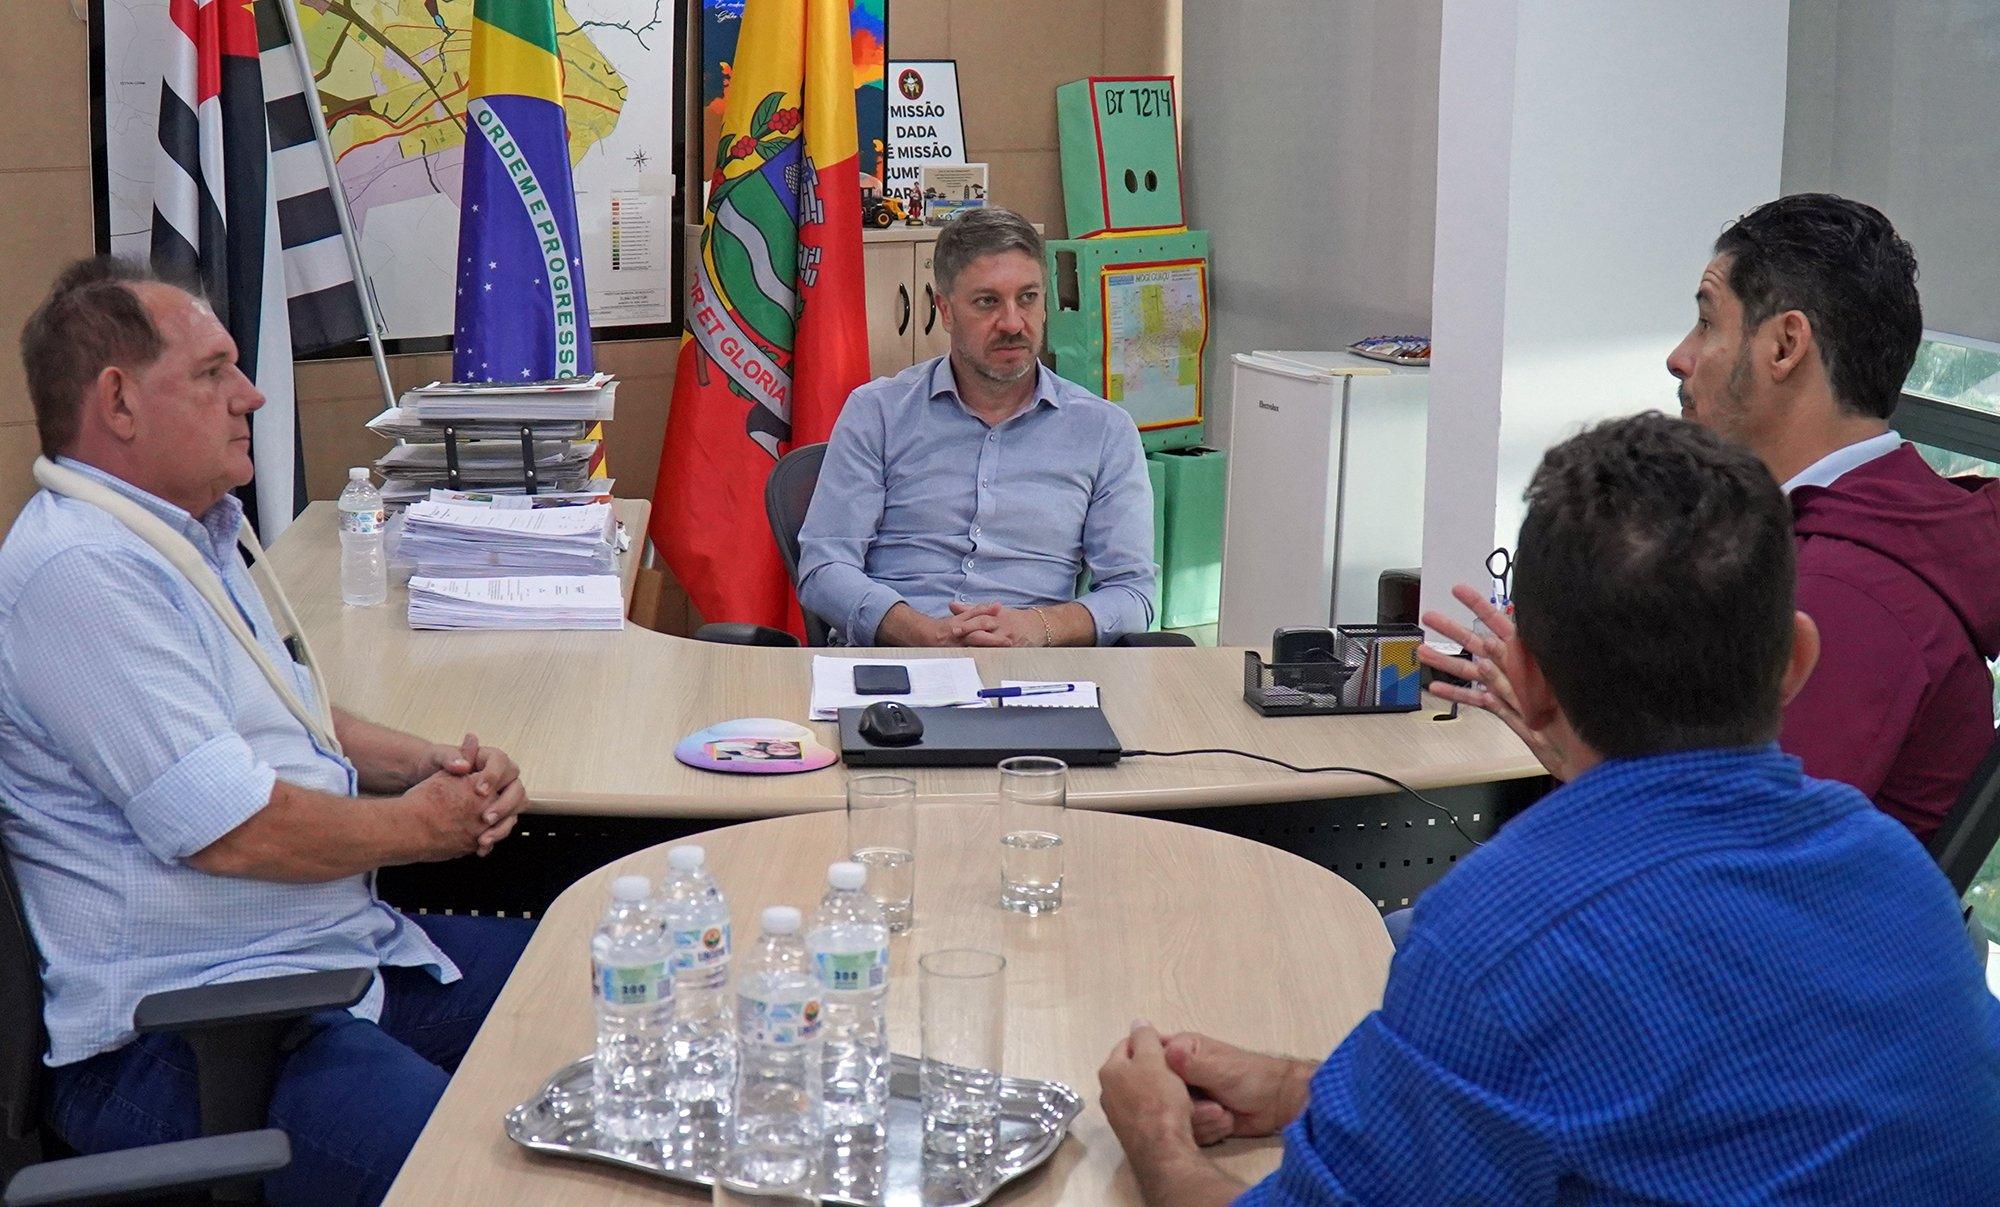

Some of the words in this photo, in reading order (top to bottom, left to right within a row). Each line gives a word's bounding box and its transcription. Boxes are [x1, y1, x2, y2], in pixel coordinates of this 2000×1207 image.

[890, 101, 945, 118] MISSÃO
[1105, 89, 1125, 115] BT
[896, 126, 938, 138] DADA
[477, 109, 538, 195] ORDEM
[898, 142, 952, 158] MISSÃO
[529, 199, 546, 215] E
[537, 219, 574, 379] PROGRESSO
[697, 306, 726, 336] ET
[720, 337, 788, 406] GLORIA
